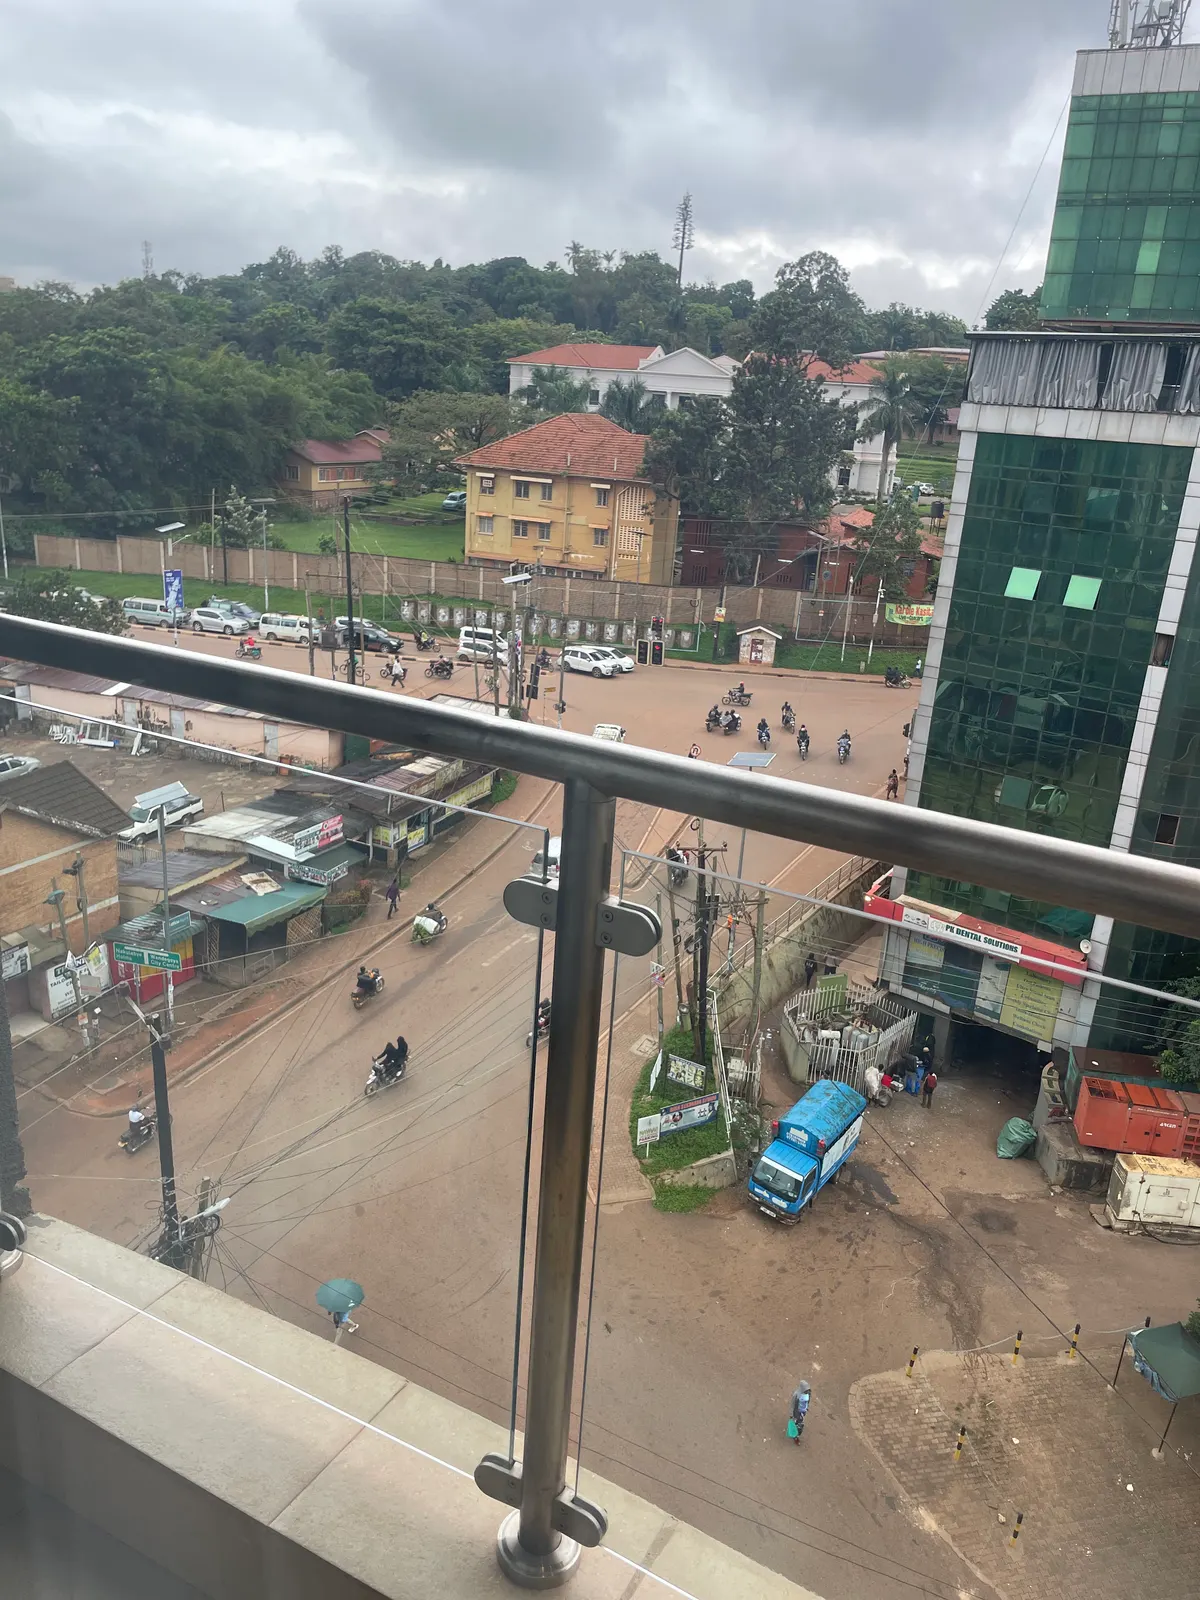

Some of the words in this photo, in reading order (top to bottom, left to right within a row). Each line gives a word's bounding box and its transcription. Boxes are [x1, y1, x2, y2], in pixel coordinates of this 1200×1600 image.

[945, 924, 955, 934] PK
[956, 928, 982, 943] DENTAL
[983, 937, 1018, 953] SOLUTIONS
[162, 961, 180, 970] Centre
